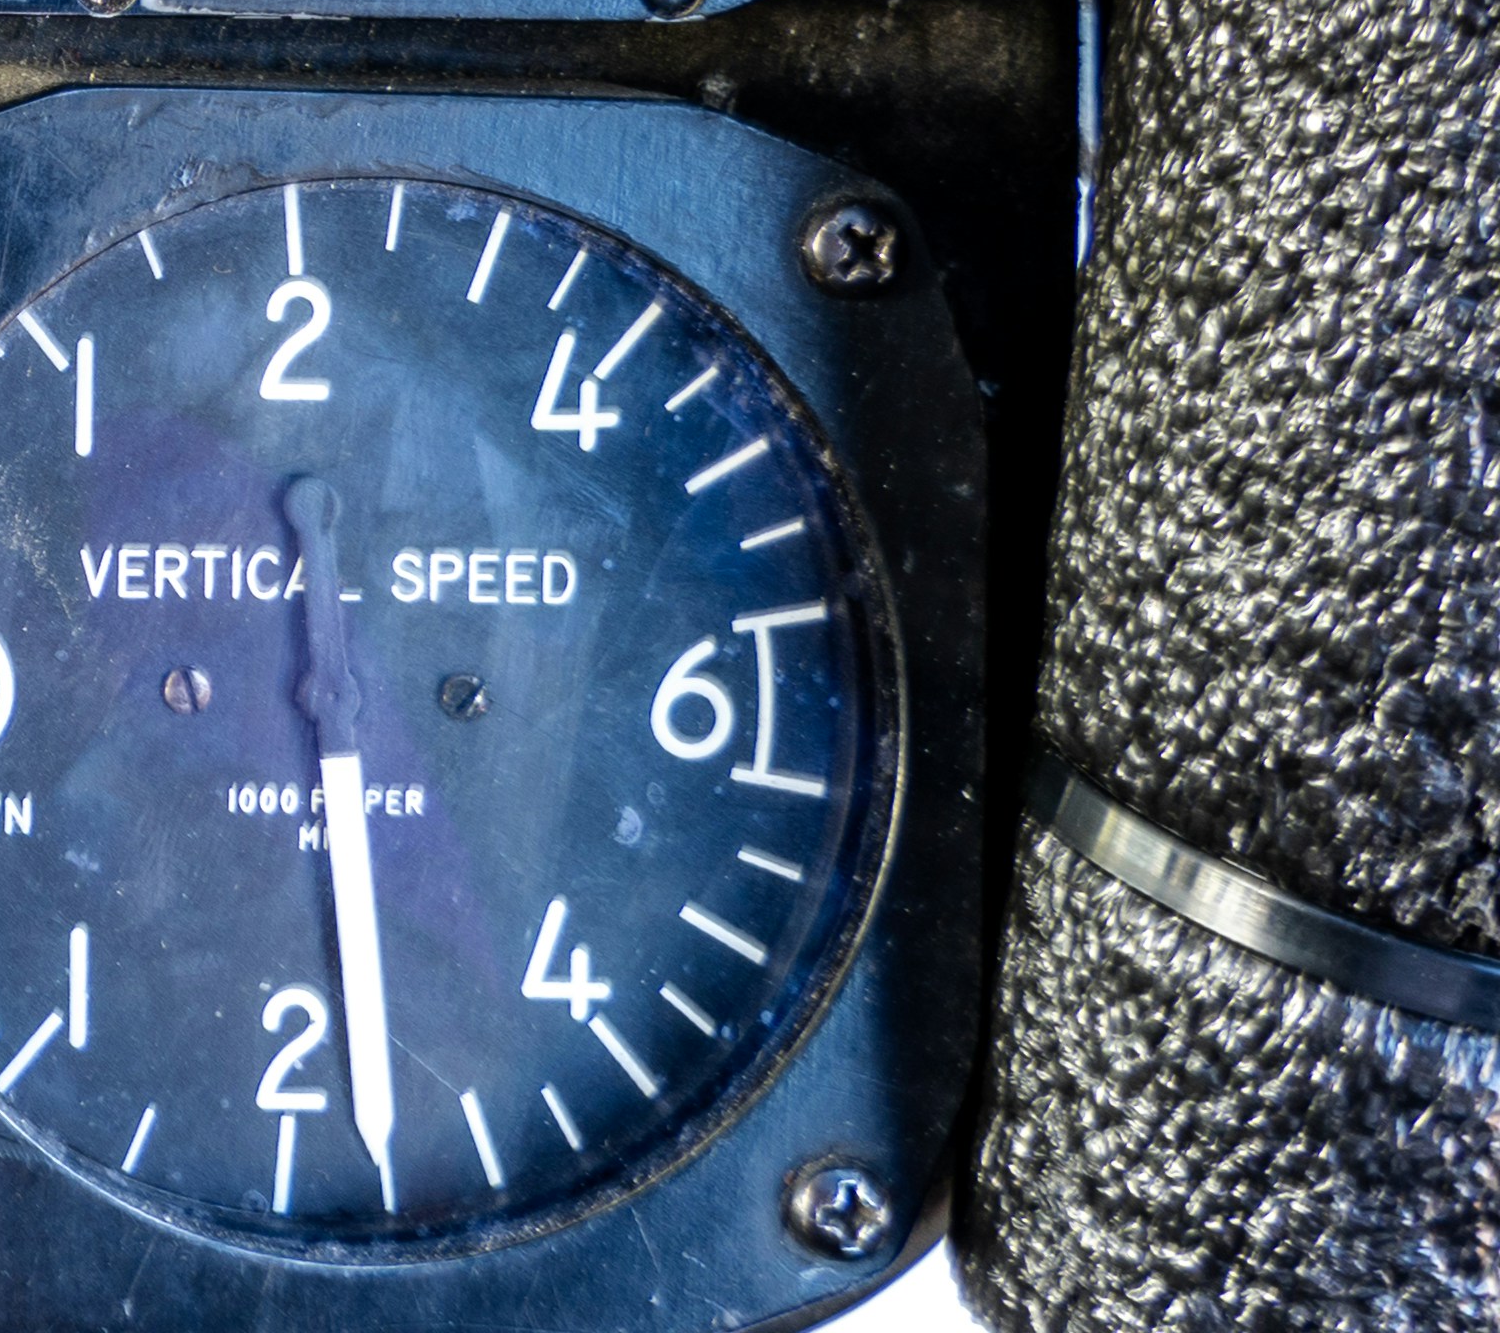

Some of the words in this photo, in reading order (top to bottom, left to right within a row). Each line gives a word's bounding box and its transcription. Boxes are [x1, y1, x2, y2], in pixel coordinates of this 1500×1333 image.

[259, 277, 331, 401] 2
[531, 331, 620, 453] 4
[80, 547, 363, 602] VERTICA
[390, 552, 577, 605] SPEED
[650, 637, 733, 761] 6
[228, 788, 298, 814] 1000
[365, 789, 424, 816] PER
[521, 899, 611, 1023] 4
[256, 988, 328, 1112] 2
